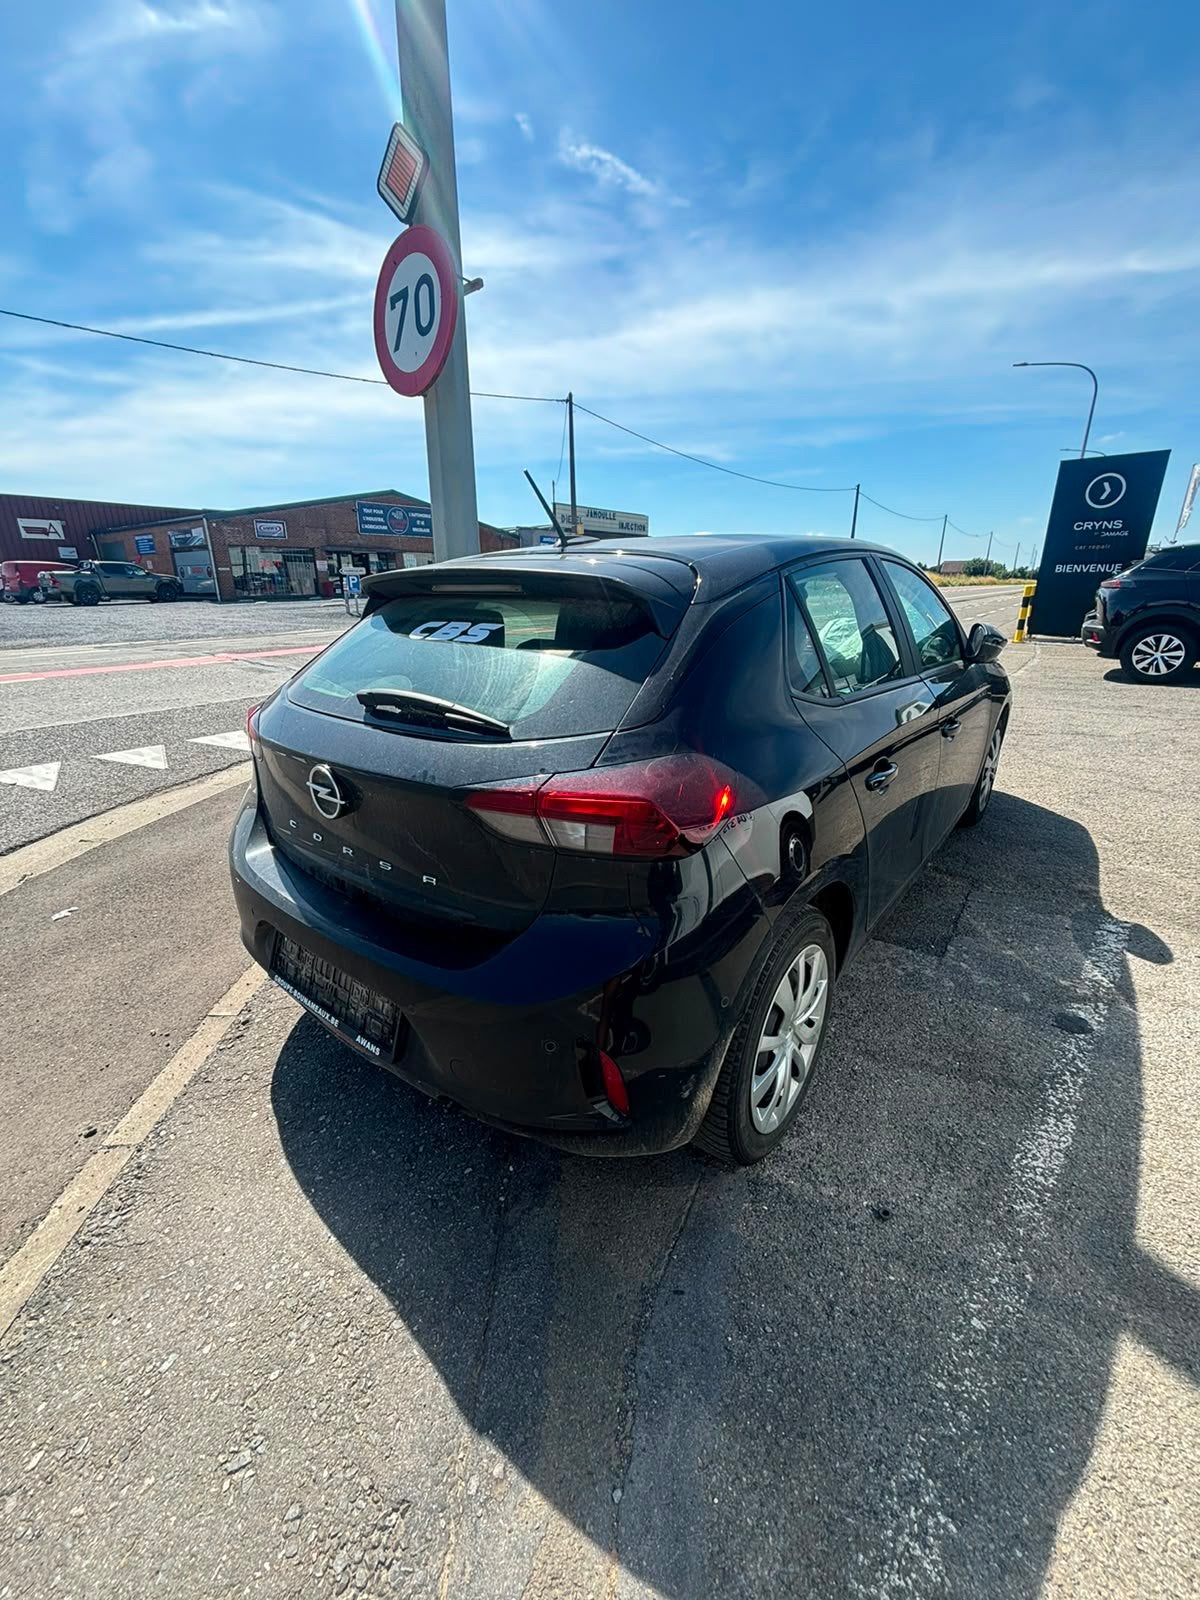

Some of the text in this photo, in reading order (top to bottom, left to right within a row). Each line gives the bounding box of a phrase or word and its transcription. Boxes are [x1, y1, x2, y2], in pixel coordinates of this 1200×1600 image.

[389, 272, 436, 354] 70
[560, 513, 584, 525] DIEEL
[618, 520, 646, 532] INJECTION
[1073, 519, 1123, 531] CRYNS
[1055, 563, 1123, 573] BIENVENUE
[349, 575, 358, 589] P
[408, 621, 505, 643] CBS
[288, 819, 437, 887] CORSA
[355, 1035, 381, 1056] AWANS
